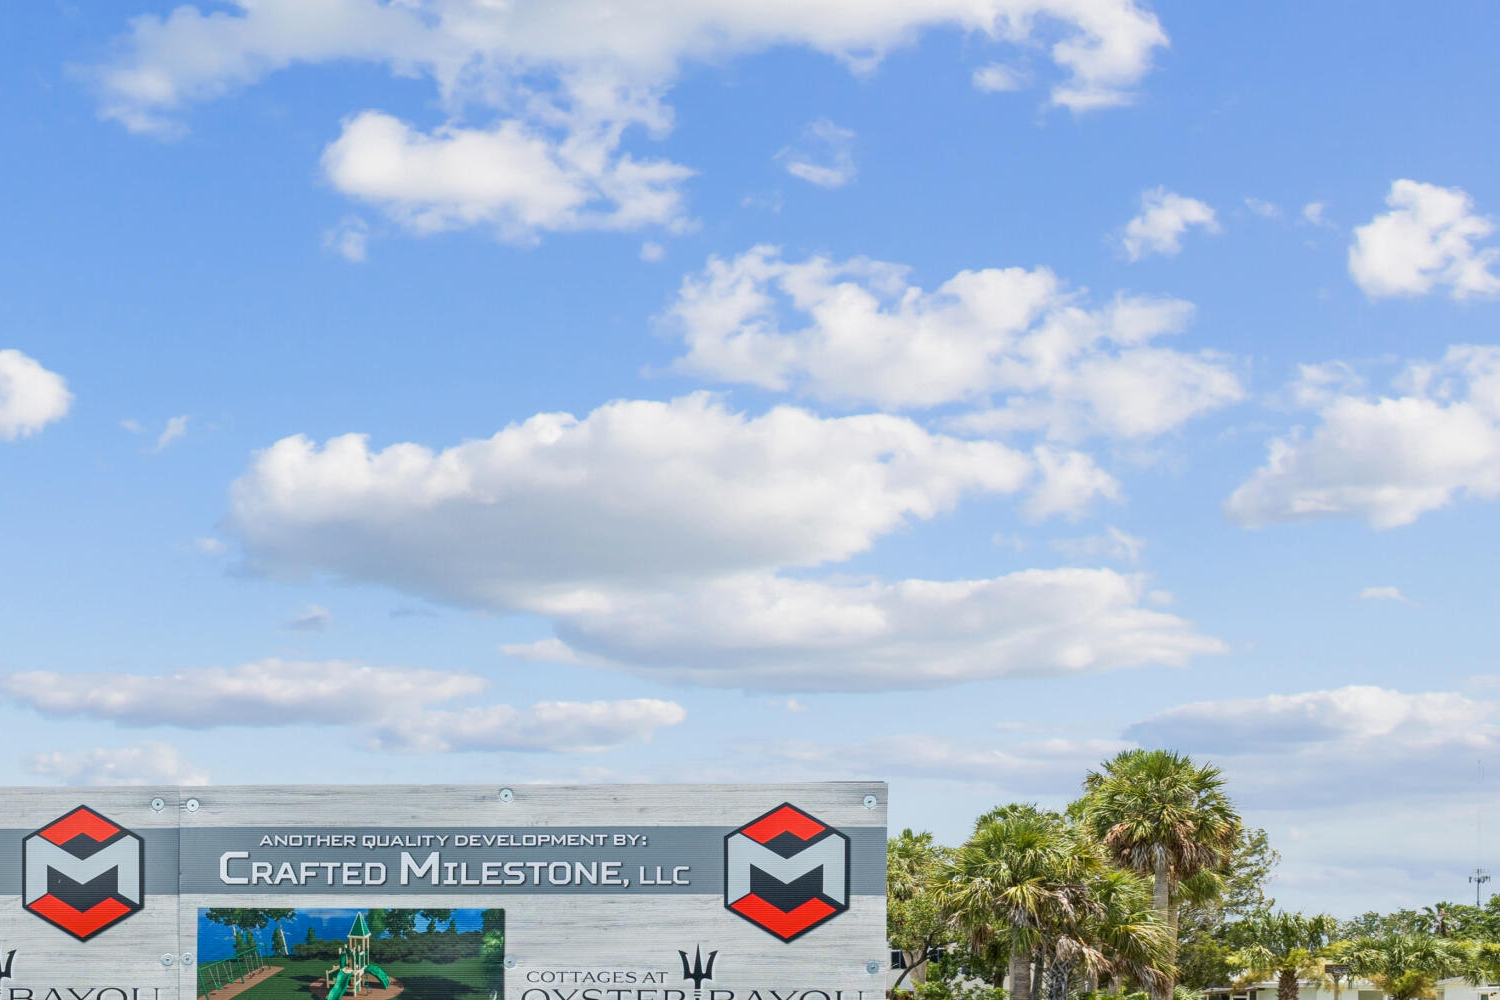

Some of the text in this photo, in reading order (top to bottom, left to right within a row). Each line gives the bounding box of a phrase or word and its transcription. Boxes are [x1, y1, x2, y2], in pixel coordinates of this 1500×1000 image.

[259, 834, 647, 849] ANOTHER QUALITY DEVELOPMENT BY:
[219, 851, 690, 888] CRAFTED MILESTONE, LLC
[526, 970, 669, 984] COTTAGES AT
